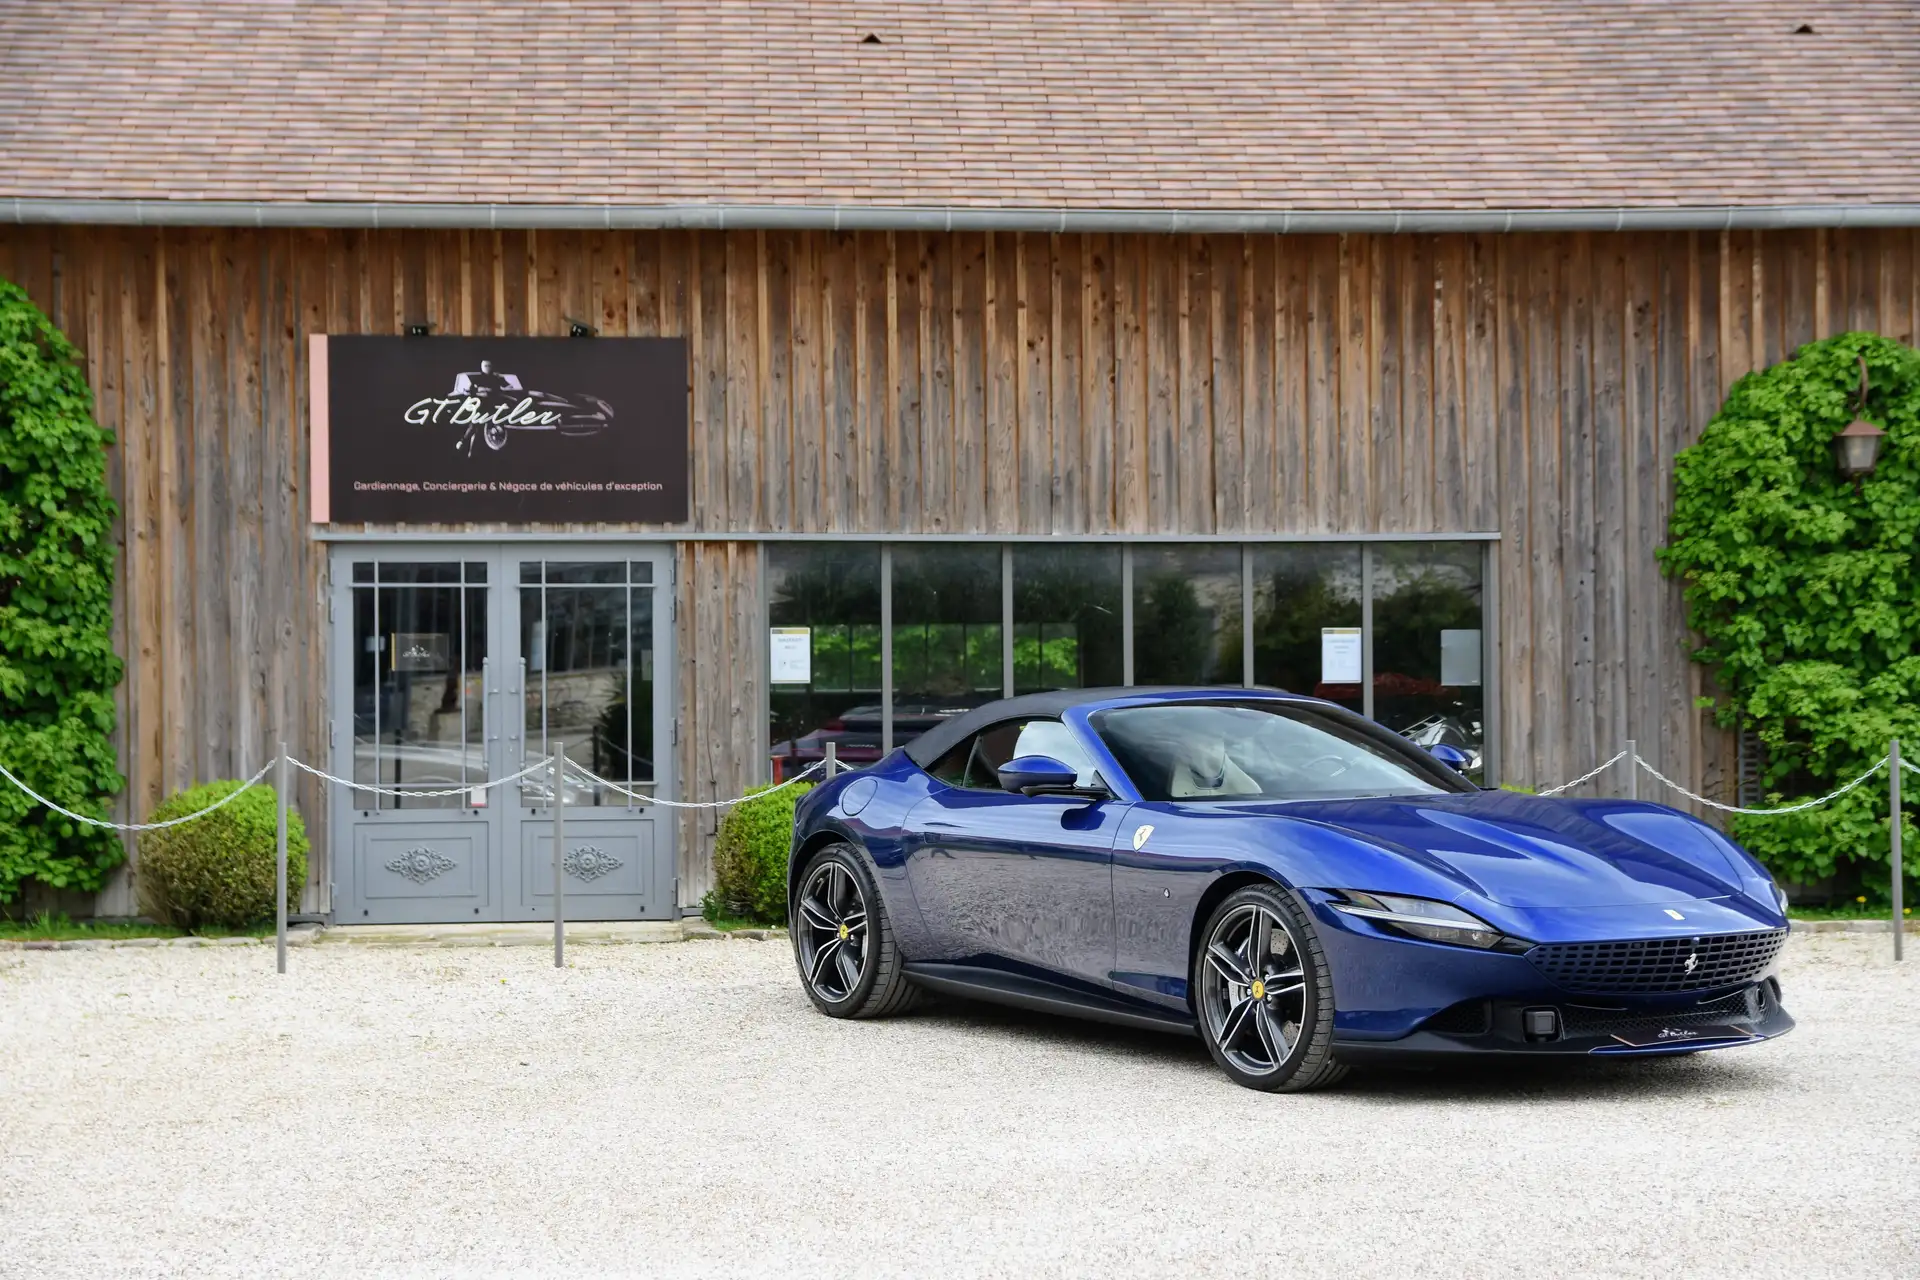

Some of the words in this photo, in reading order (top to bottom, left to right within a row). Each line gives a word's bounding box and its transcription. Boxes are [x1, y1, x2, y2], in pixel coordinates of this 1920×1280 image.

[404, 397, 460, 425] GT
[450, 396, 561, 425] Butler
[353, 480, 420, 493] Gardiennage,
[422, 480, 487, 493] Conciergerie
[489, 481, 497, 491] &
[498, 480, 537, 493] Négoce
[539, 480, 553, 491] de
[555, 480, 603, 491] véhicules
[605, 480, 663, 493] d'exception
